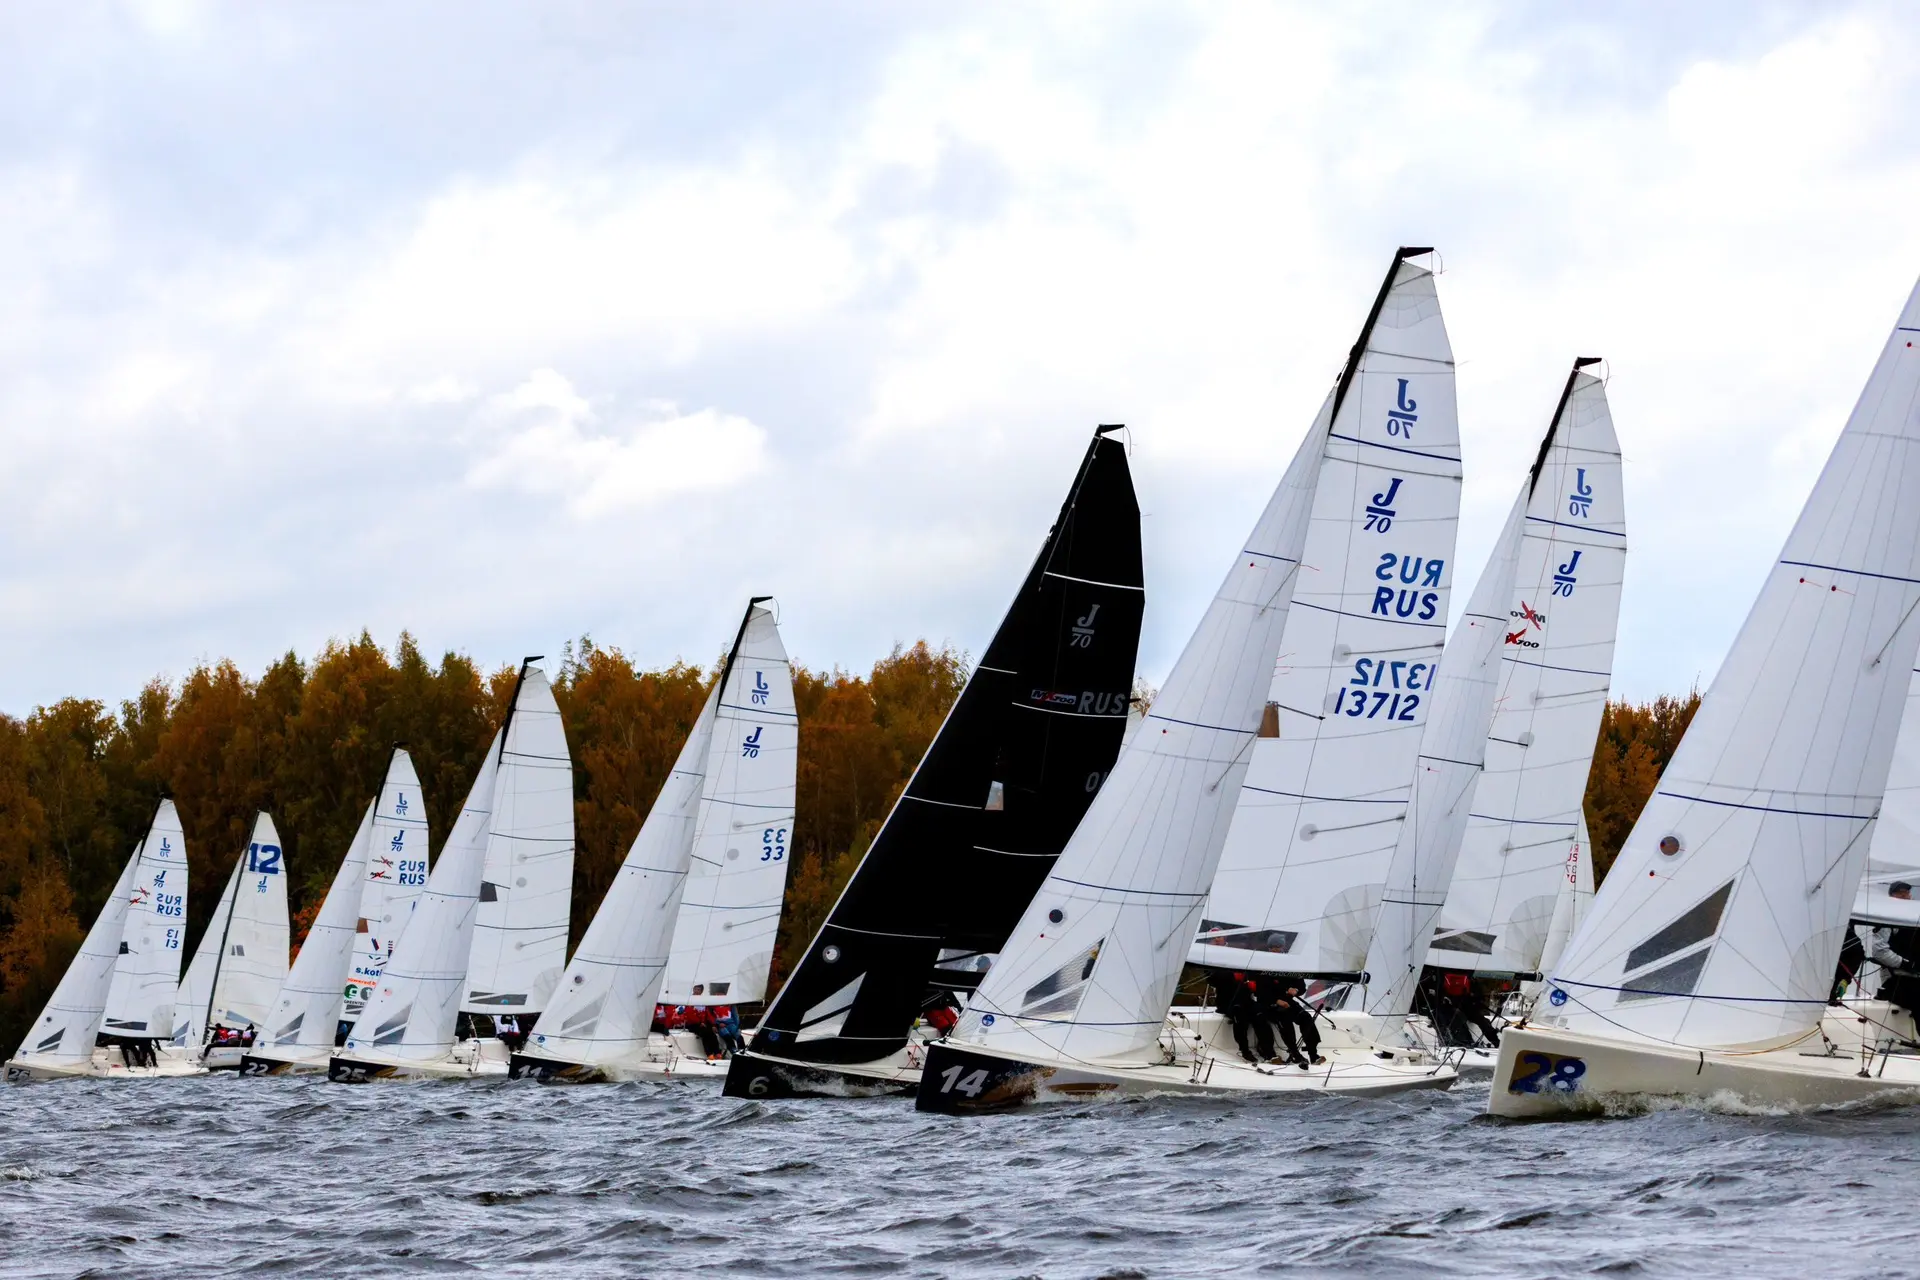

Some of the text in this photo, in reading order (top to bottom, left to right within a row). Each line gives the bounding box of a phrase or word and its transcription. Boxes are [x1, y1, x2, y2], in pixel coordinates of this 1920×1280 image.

[1372, 477, 1404, 507] J
[1363, 513, 1392, 533] 70
[1558, 550, 1582, 575] J
[1552, 581, 1573, 597] 70
[1371, 586, 1439, 620] RUS
[1077, 604, 1101, 628] J
[1070, 632, 1092, 648] 70
[1077, 691, 1126, 715] RUS
[1334, 687, 1420, 721] 13712
[745, 726, 764, 744] J
[742, 747, 759, 758] 70
[393, 830, 405, 842] J
[391, 844, 403, 852] 70
[760, 845, 785, 861] 33
[249, 842, 281, 874] 12
[258, 875, 268, 886] J
[398, 873, 425, 885] RUS
[156, 903, 182, 916] RUS
[165, 939, 179, 949] 13
[245, 1062, 269, 1077] 22
[335, 1066, 367, 1081] 25
[1511, 1054, 1586, 1094] 28
[749, 1076, 769, 1095] 6
[941, 1065, 989, 1098] 14
